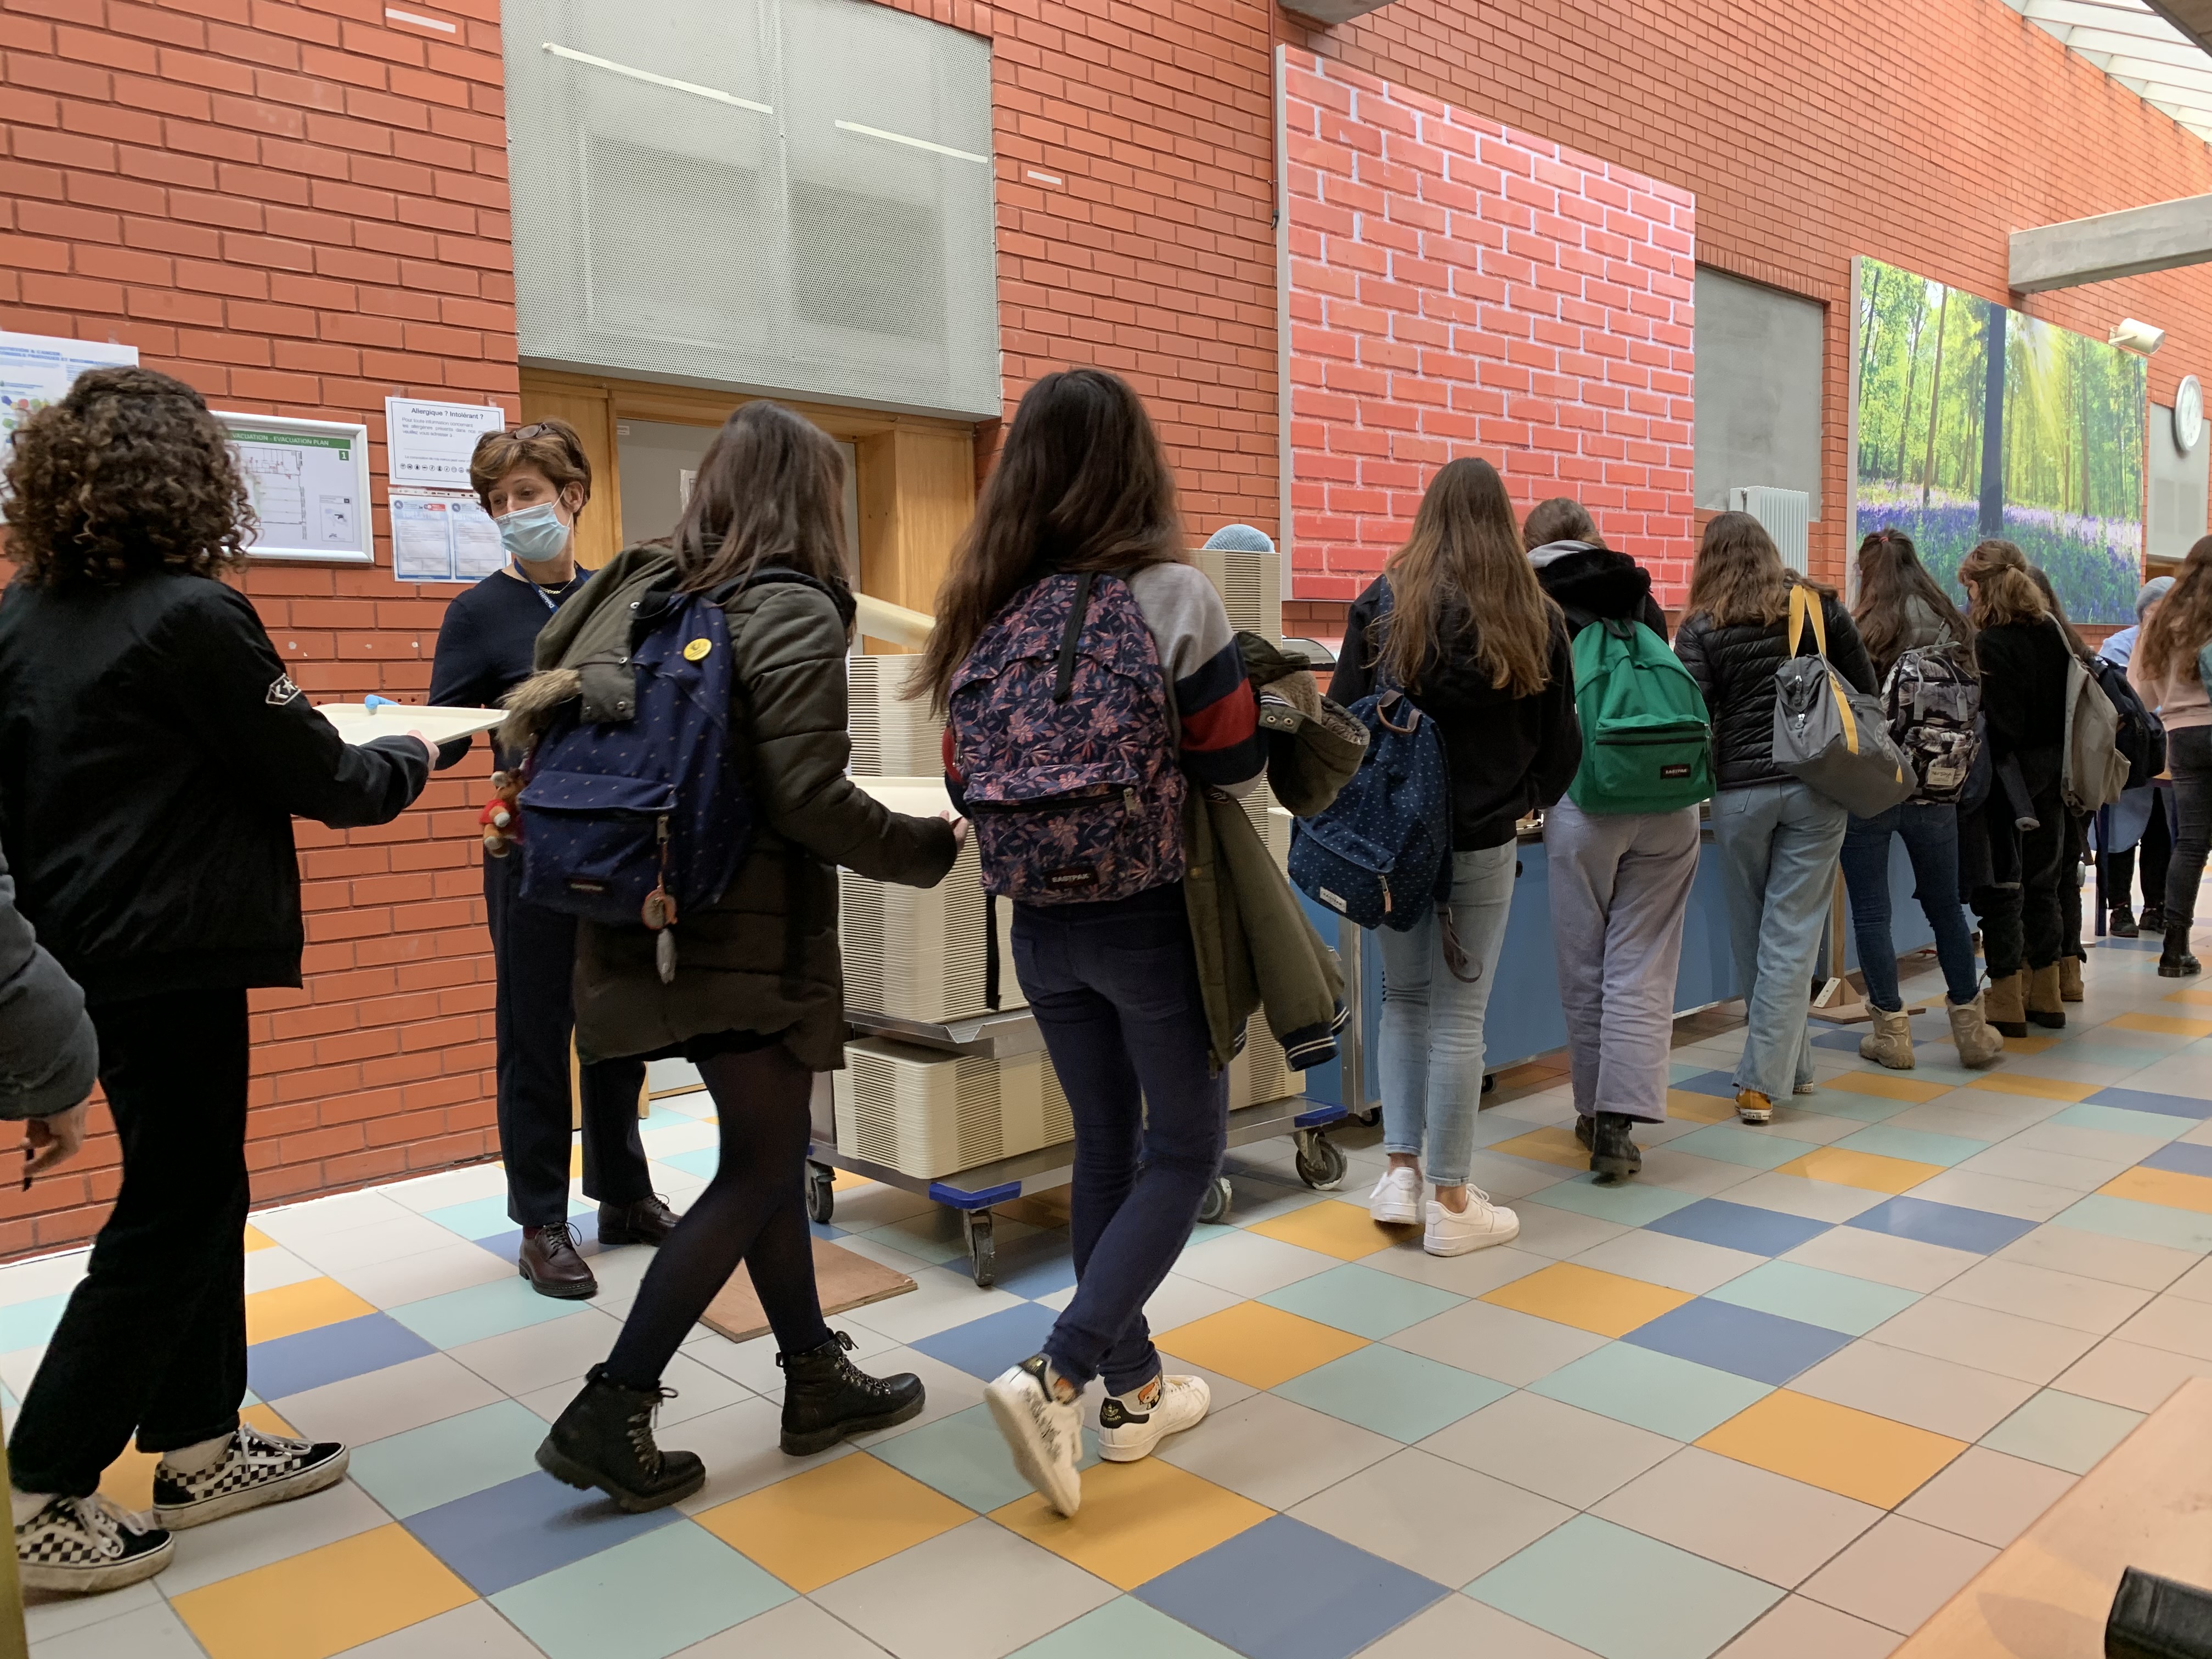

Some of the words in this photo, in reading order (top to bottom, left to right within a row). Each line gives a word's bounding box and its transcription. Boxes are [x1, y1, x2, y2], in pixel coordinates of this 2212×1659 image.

[411, 408, 443, 416] Allergique
[450, 411, 478, 419] Intolérant
[233, 433, 268, 441] VACUATION
[273, 436, 312, 445] EVACUATION
[1052, 873, 1090, 883] EASTPAK
